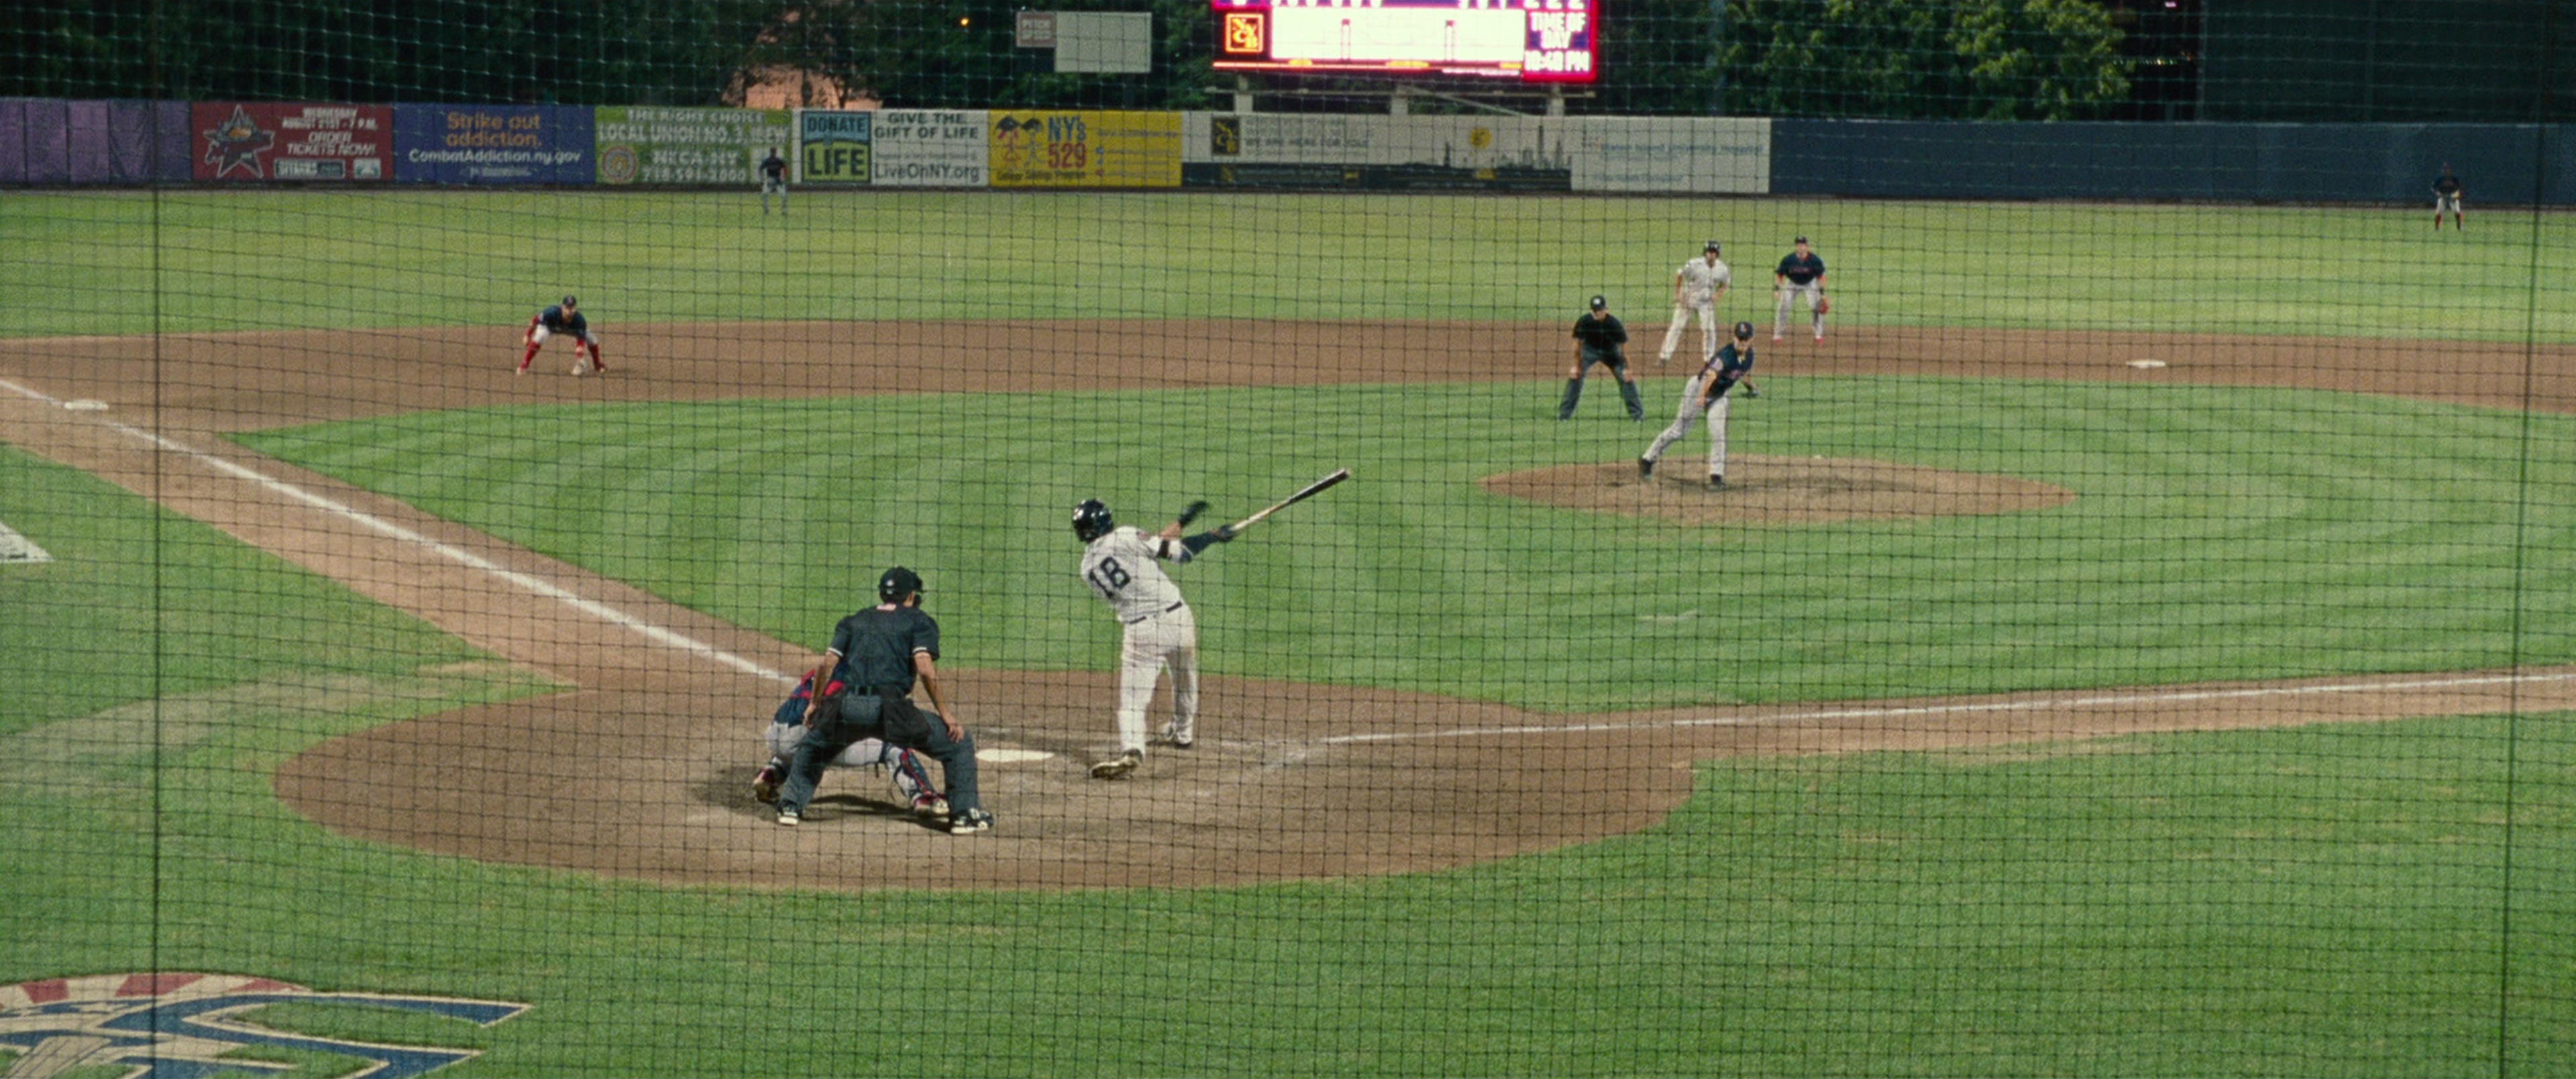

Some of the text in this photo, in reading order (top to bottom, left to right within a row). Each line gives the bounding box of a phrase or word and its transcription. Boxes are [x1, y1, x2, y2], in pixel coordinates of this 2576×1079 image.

[1529, 12, 1586, 32] TIME OF
[1540, 31, 1571, 49] DAY
[1565, 51, 1591, 72] PM
[447, 111, 540, 130] Strike out
[629, 109, 763, 123] THE RIGHT CHOICE
[807, 116, 865, 133] DONATE
[888, 113, 966, 124] GIVE THE
[308, 132, 352, 144] ORDER
[598, 123, 646, 142] LOCAL
[650, 124, 700, 143] UNION
[875, 126, 979, 140] GIFT OF LIFE
[1048, 116, 1087, 142] NY's
[446, 131, 542, 147] addiction.
[287, 143, 376, 156] TICKETS NOW!
[409, 148, 580, 164] CombatAddiction.ny.gov
[1048, 142, 1087, 168] 529
[808, 149, 865, 176] LIFE
[875, 163, 979, 183] LiveOnNY.org
[1089, 556, 1130, 599] 18
